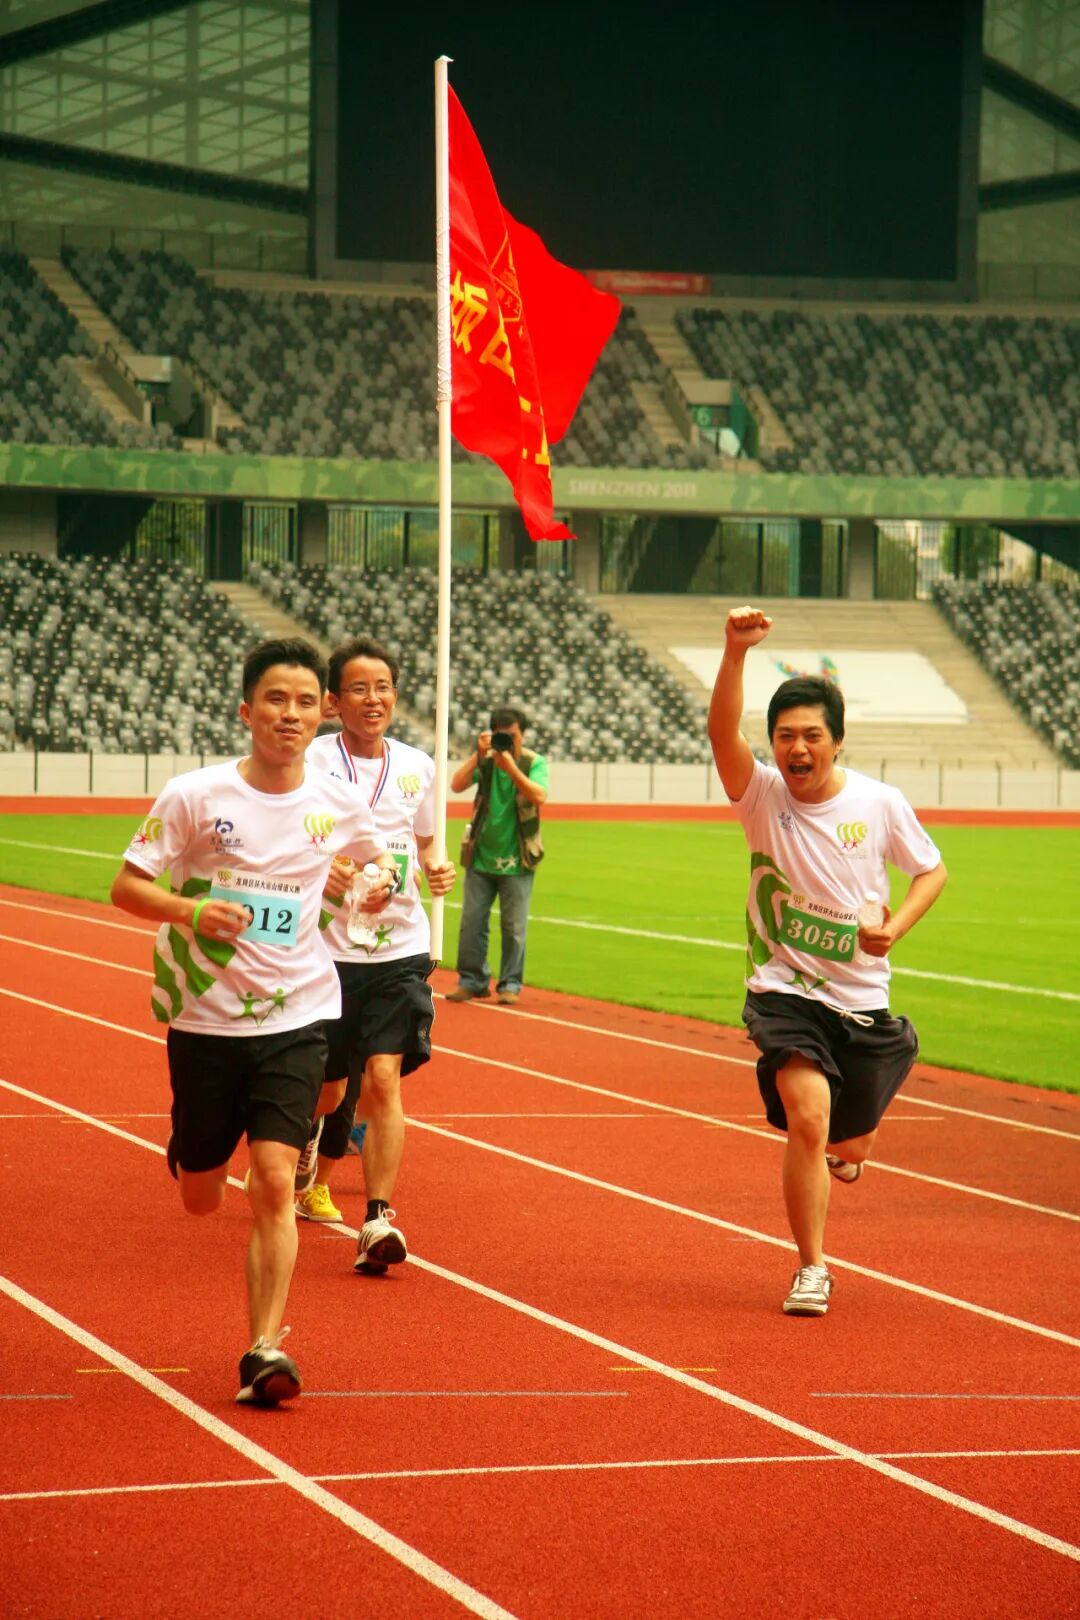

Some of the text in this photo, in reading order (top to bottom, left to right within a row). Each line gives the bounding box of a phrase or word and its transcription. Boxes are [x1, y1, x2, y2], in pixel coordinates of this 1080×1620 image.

[697, 406, 711, 426] 6
[568, 479, 697, 499] SHENZHEN 2011
[787, 918, 853, 954] 3056
